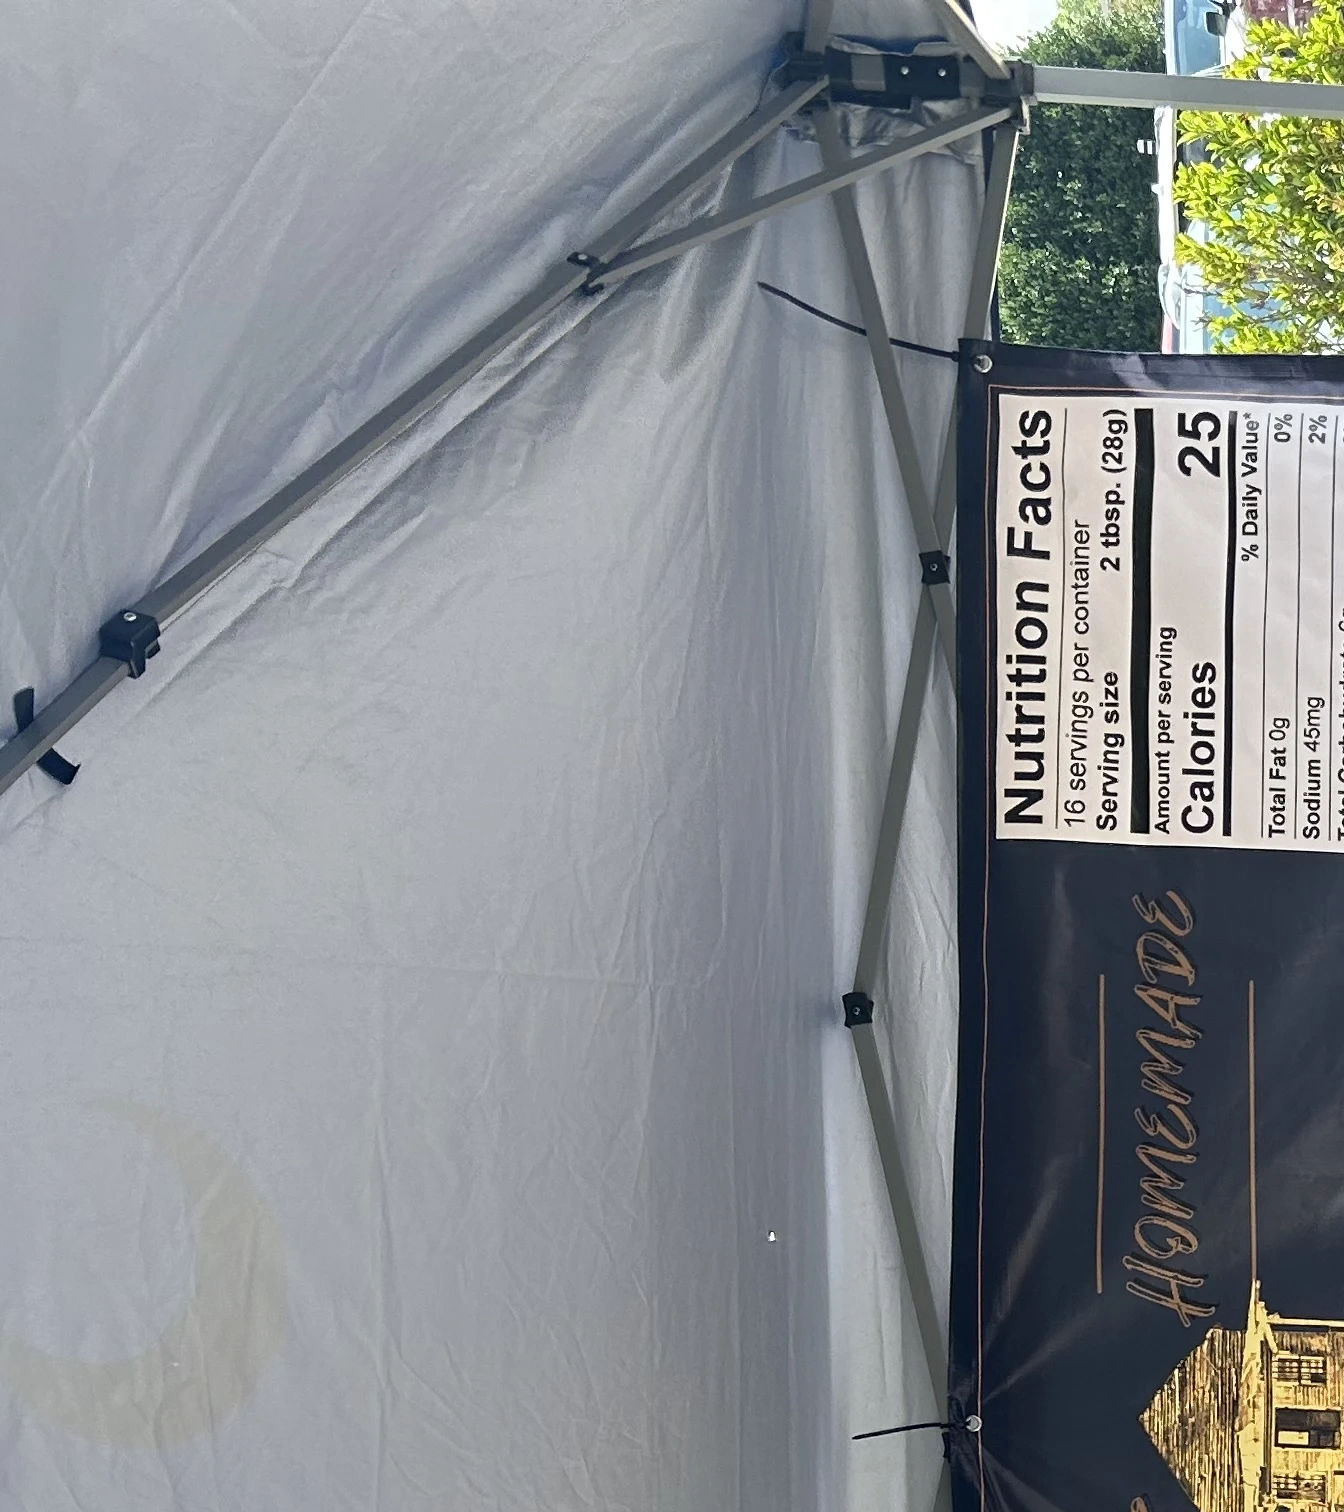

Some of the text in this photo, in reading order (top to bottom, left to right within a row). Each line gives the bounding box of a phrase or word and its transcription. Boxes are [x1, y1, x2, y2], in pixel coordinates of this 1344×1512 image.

[1004, 411, 1052, 824] Nutrition Facts
[1064, 520, 1094, 827] 16 servings per container
[1096, 410, 1128, 830] Serving size 2 tbsp. (28g)
[1178, 412, 1221, 833] Calories 25
[1242, 484, 1262, 536] Daily
[1269, 414, 1292, 838] Total Fat 0g 0%
[1303, 415, 1327, 839] Sodium 45mg 2%
[1155, 628, 1177, 834] Amount per serving
[1126, 888, 1213, 1328] HOMEMADE
